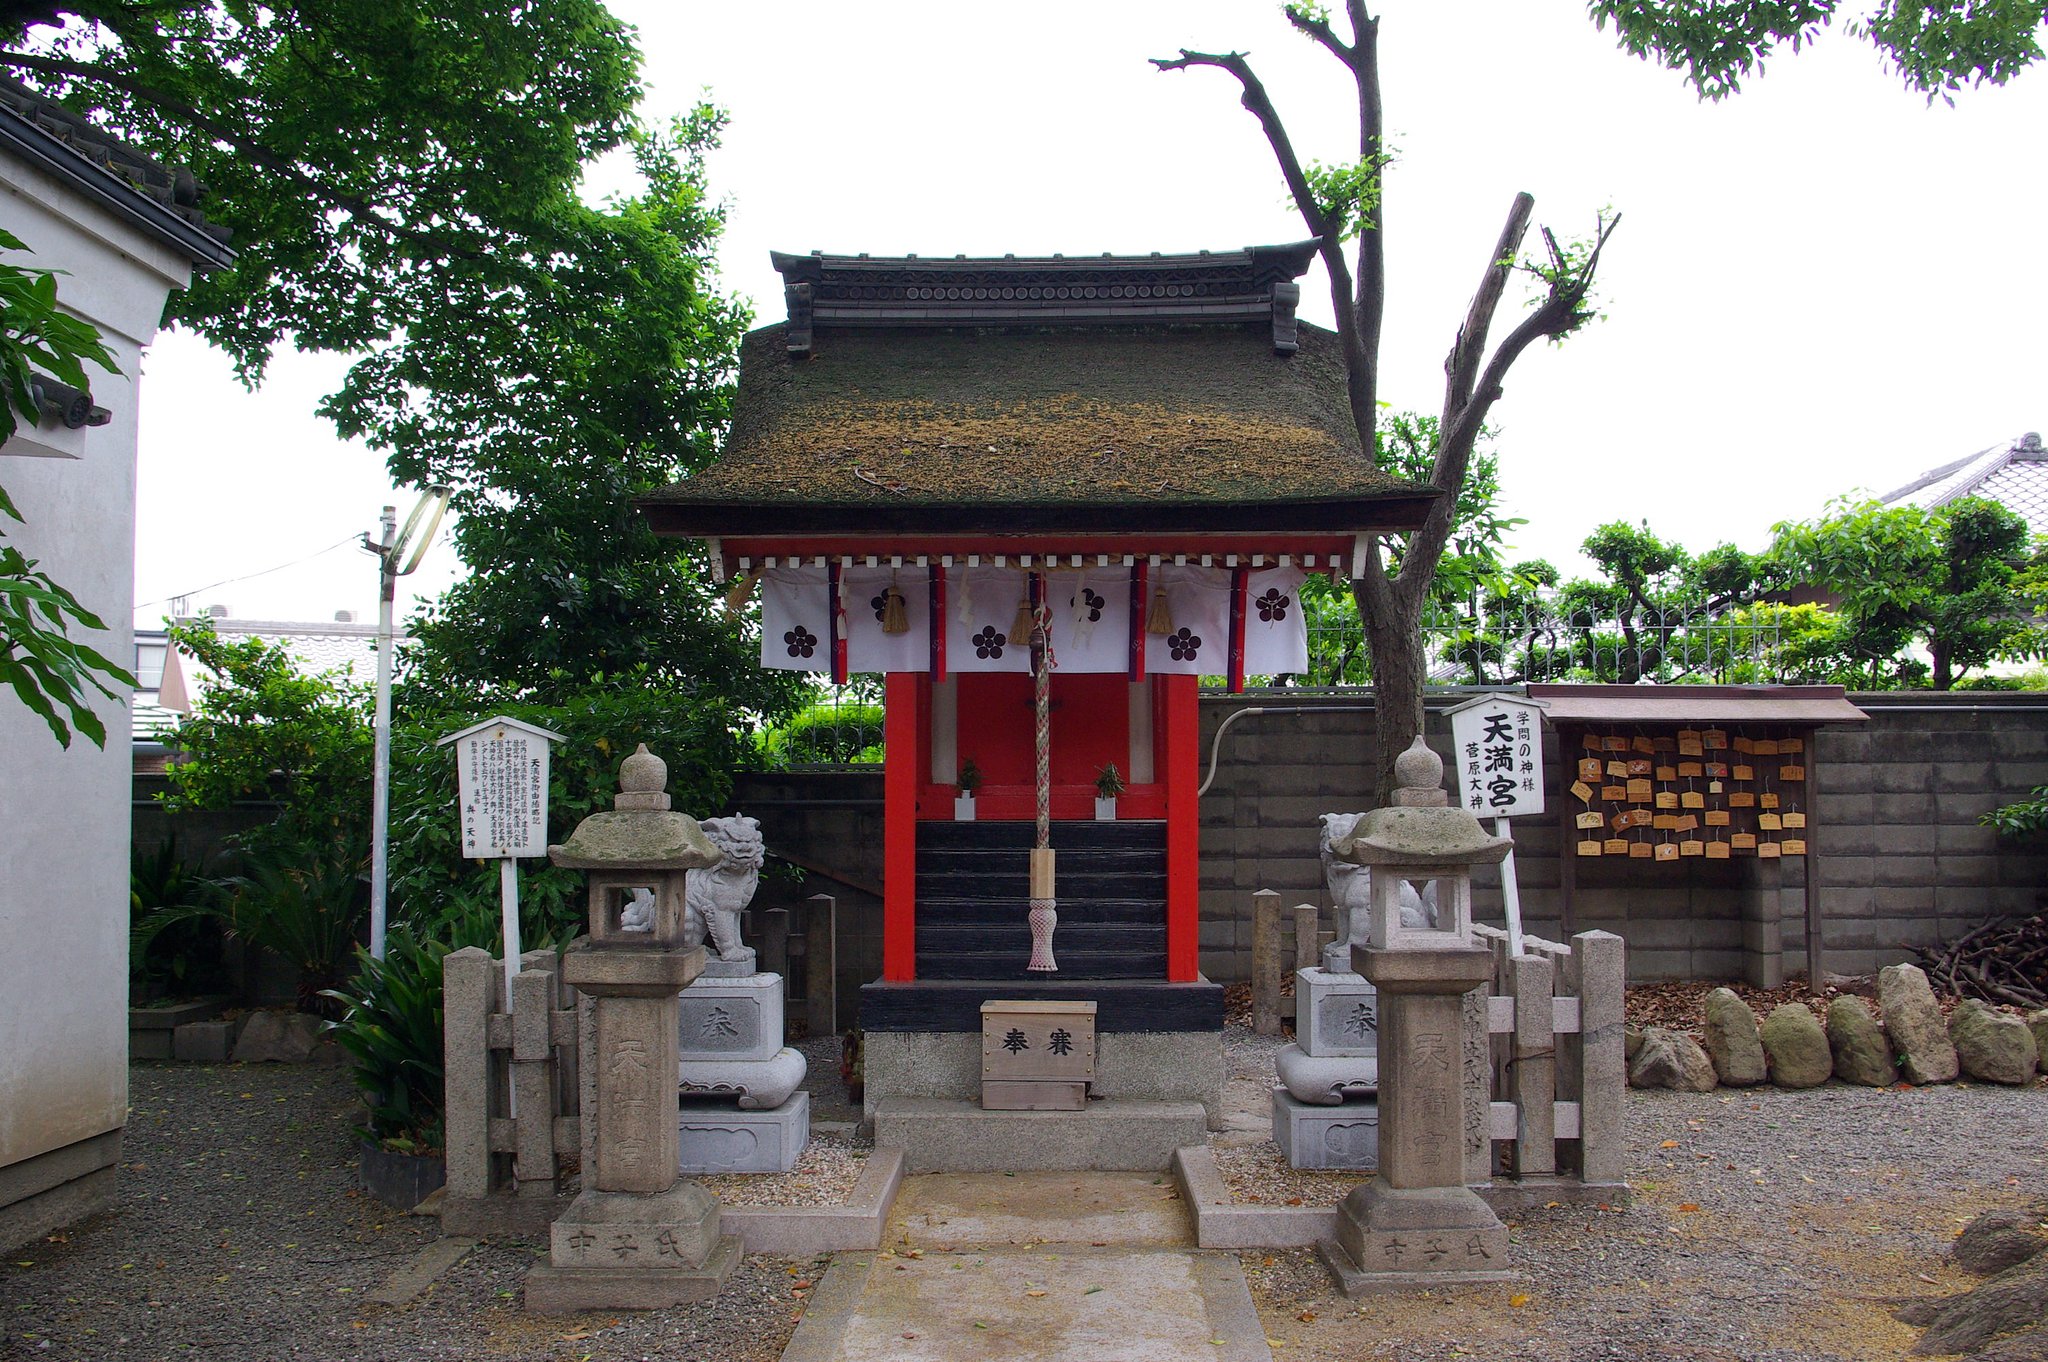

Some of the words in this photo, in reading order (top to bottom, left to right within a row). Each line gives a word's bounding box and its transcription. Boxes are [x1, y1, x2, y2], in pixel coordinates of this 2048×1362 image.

[1465, 741, 1483, 810] 菅原大神
[1483, 713, 1517, 807] 天満宮
[1516, 711, 1535, 792] 学問の神様
